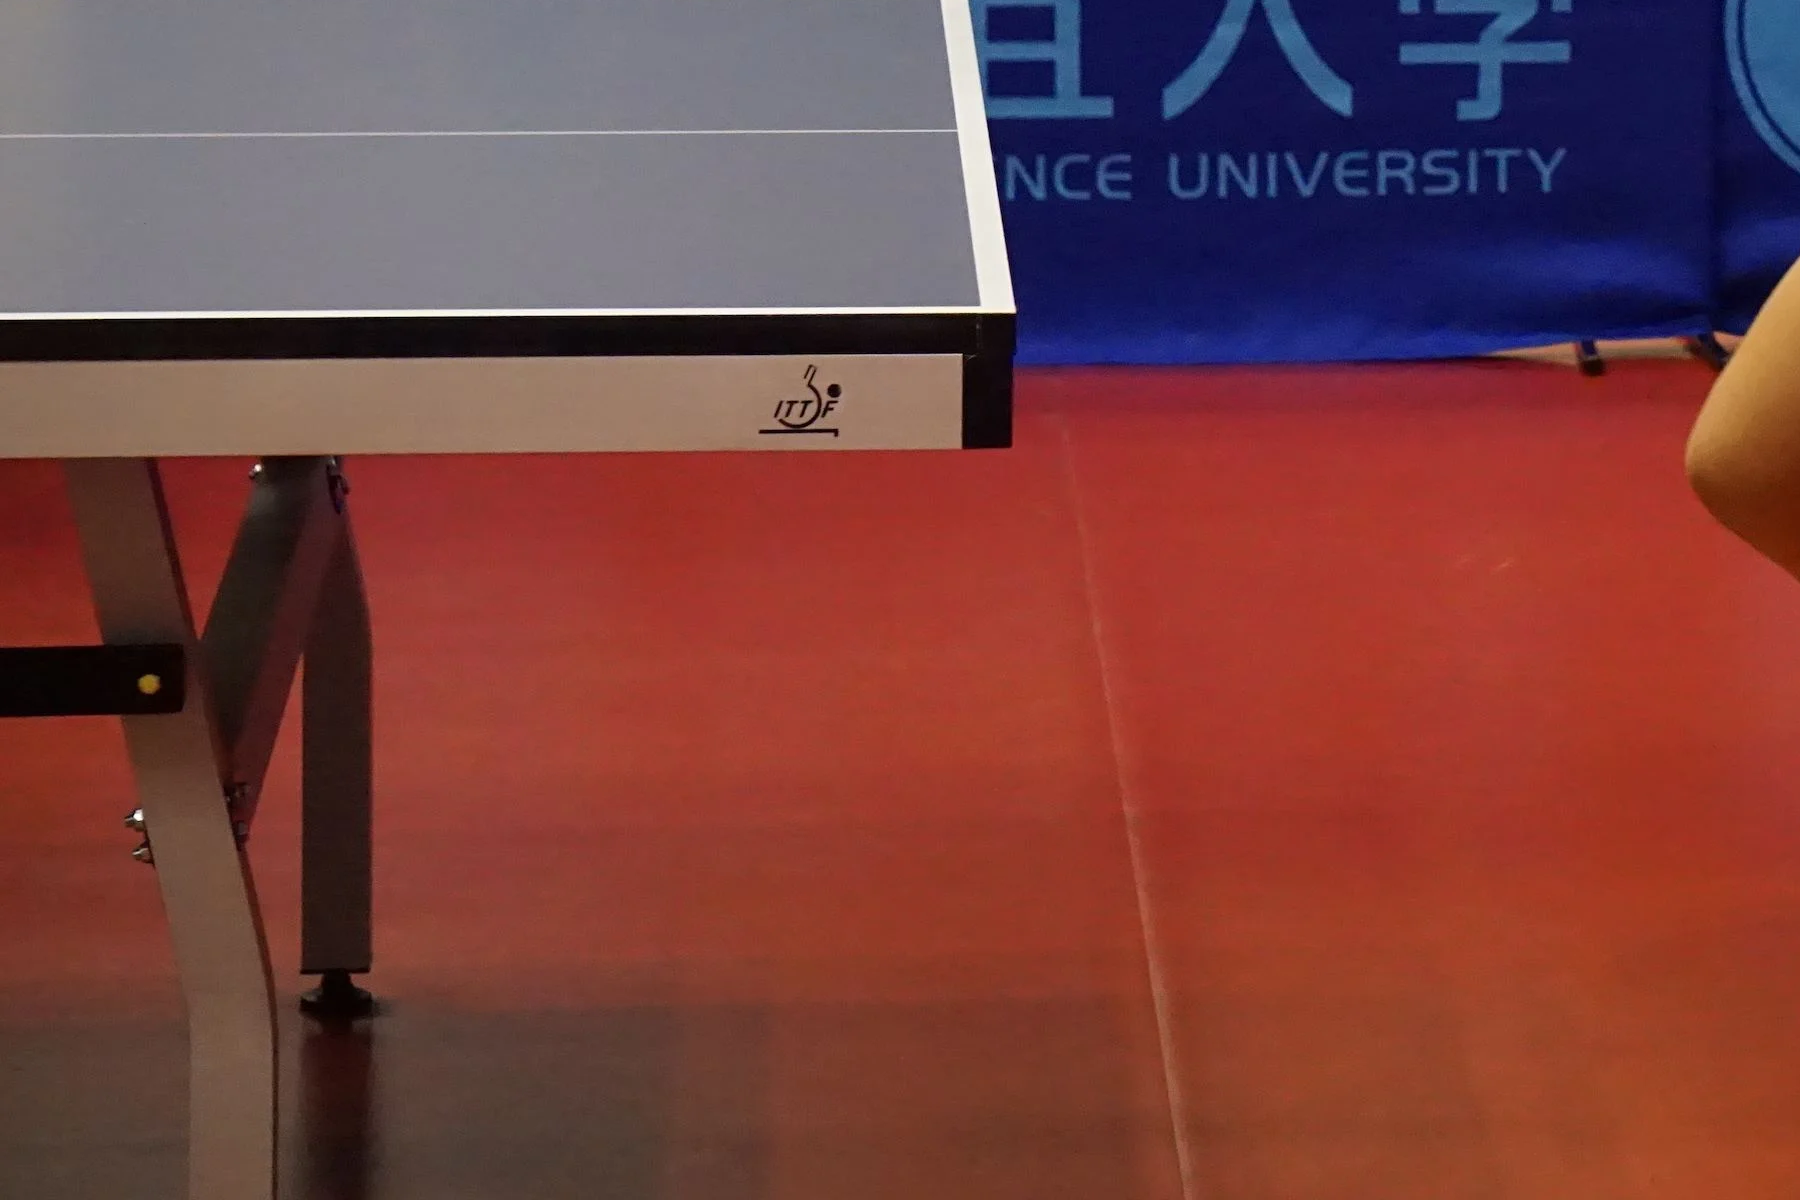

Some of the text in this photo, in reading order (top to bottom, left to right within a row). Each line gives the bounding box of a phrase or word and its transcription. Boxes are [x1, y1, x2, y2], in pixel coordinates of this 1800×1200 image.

[1004, 147, 1568, 202] NCE UNIVERSITY
[774, 400, 839, 419] ITTF
